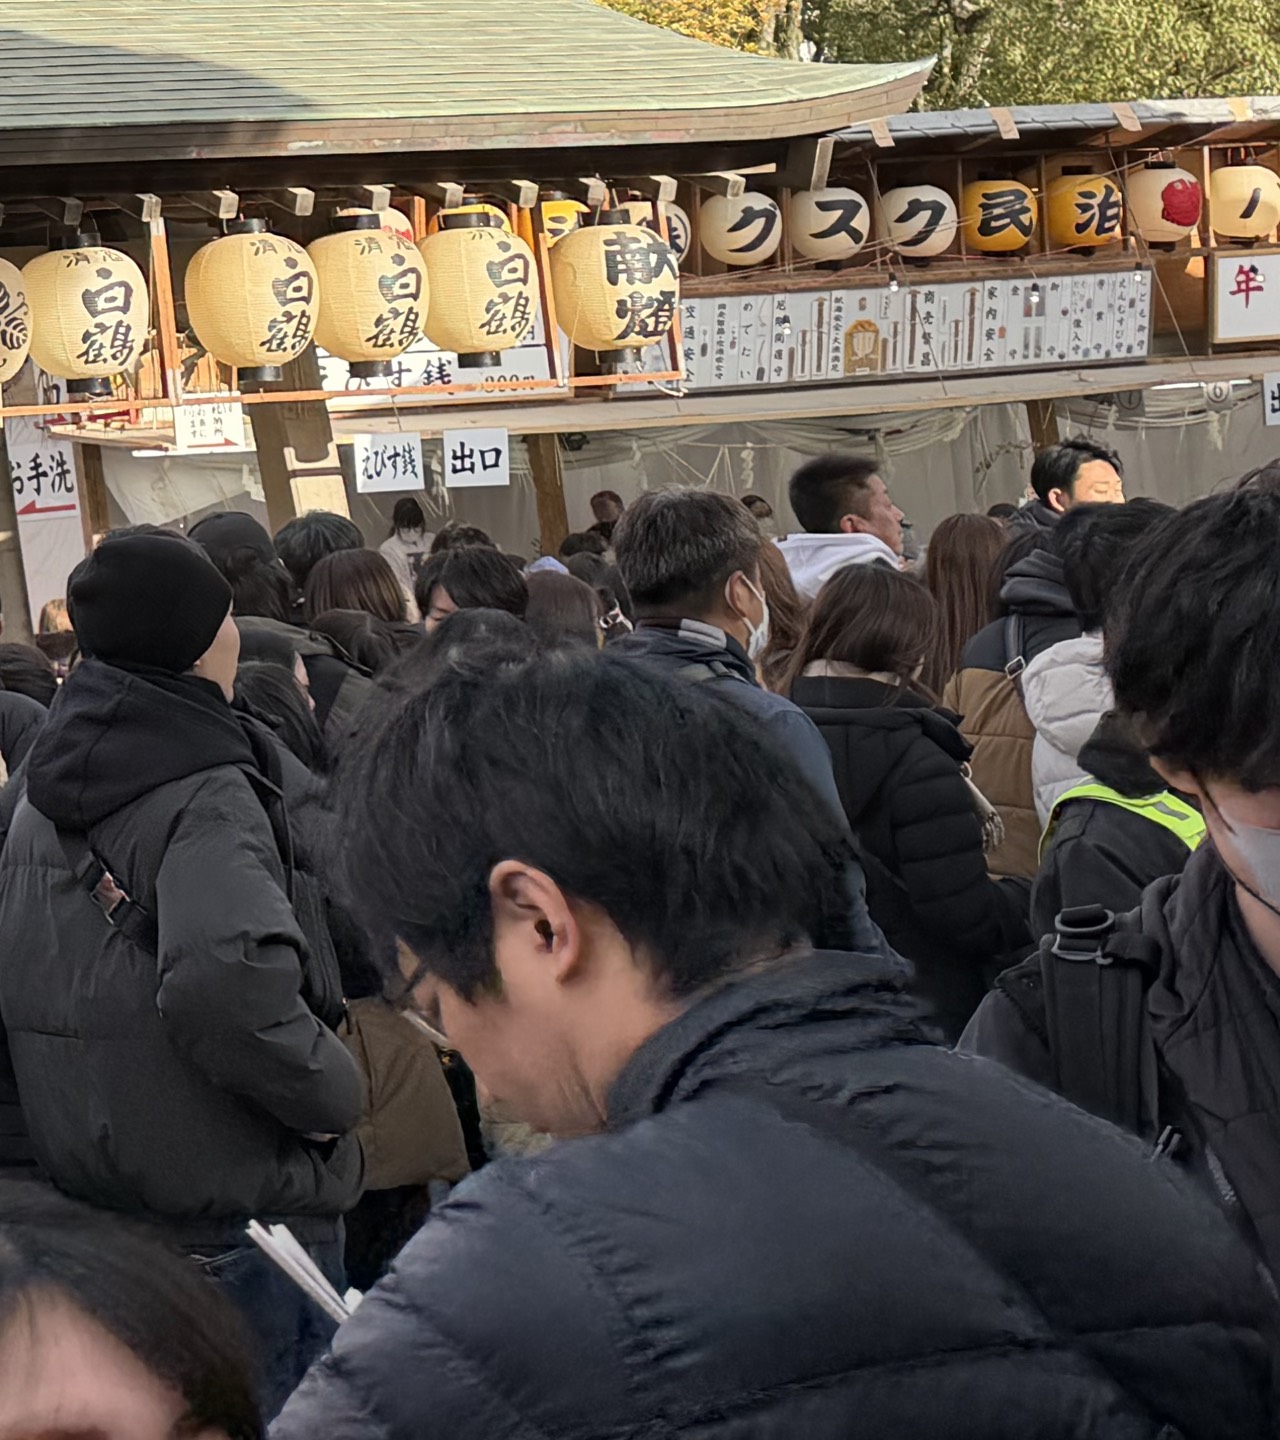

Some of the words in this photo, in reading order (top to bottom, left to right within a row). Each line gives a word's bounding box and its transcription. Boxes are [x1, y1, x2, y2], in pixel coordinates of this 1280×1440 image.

[76, 267, 136, 367] 白鶴
[260, 257, 314, 354] 白鶴
[365, 253, 424, 352] 白鶴
[478, 240, 533, 340] 白鶴
[362, 442, 419, 480] えびす銭
[451, 441, 503, 475] 出口
